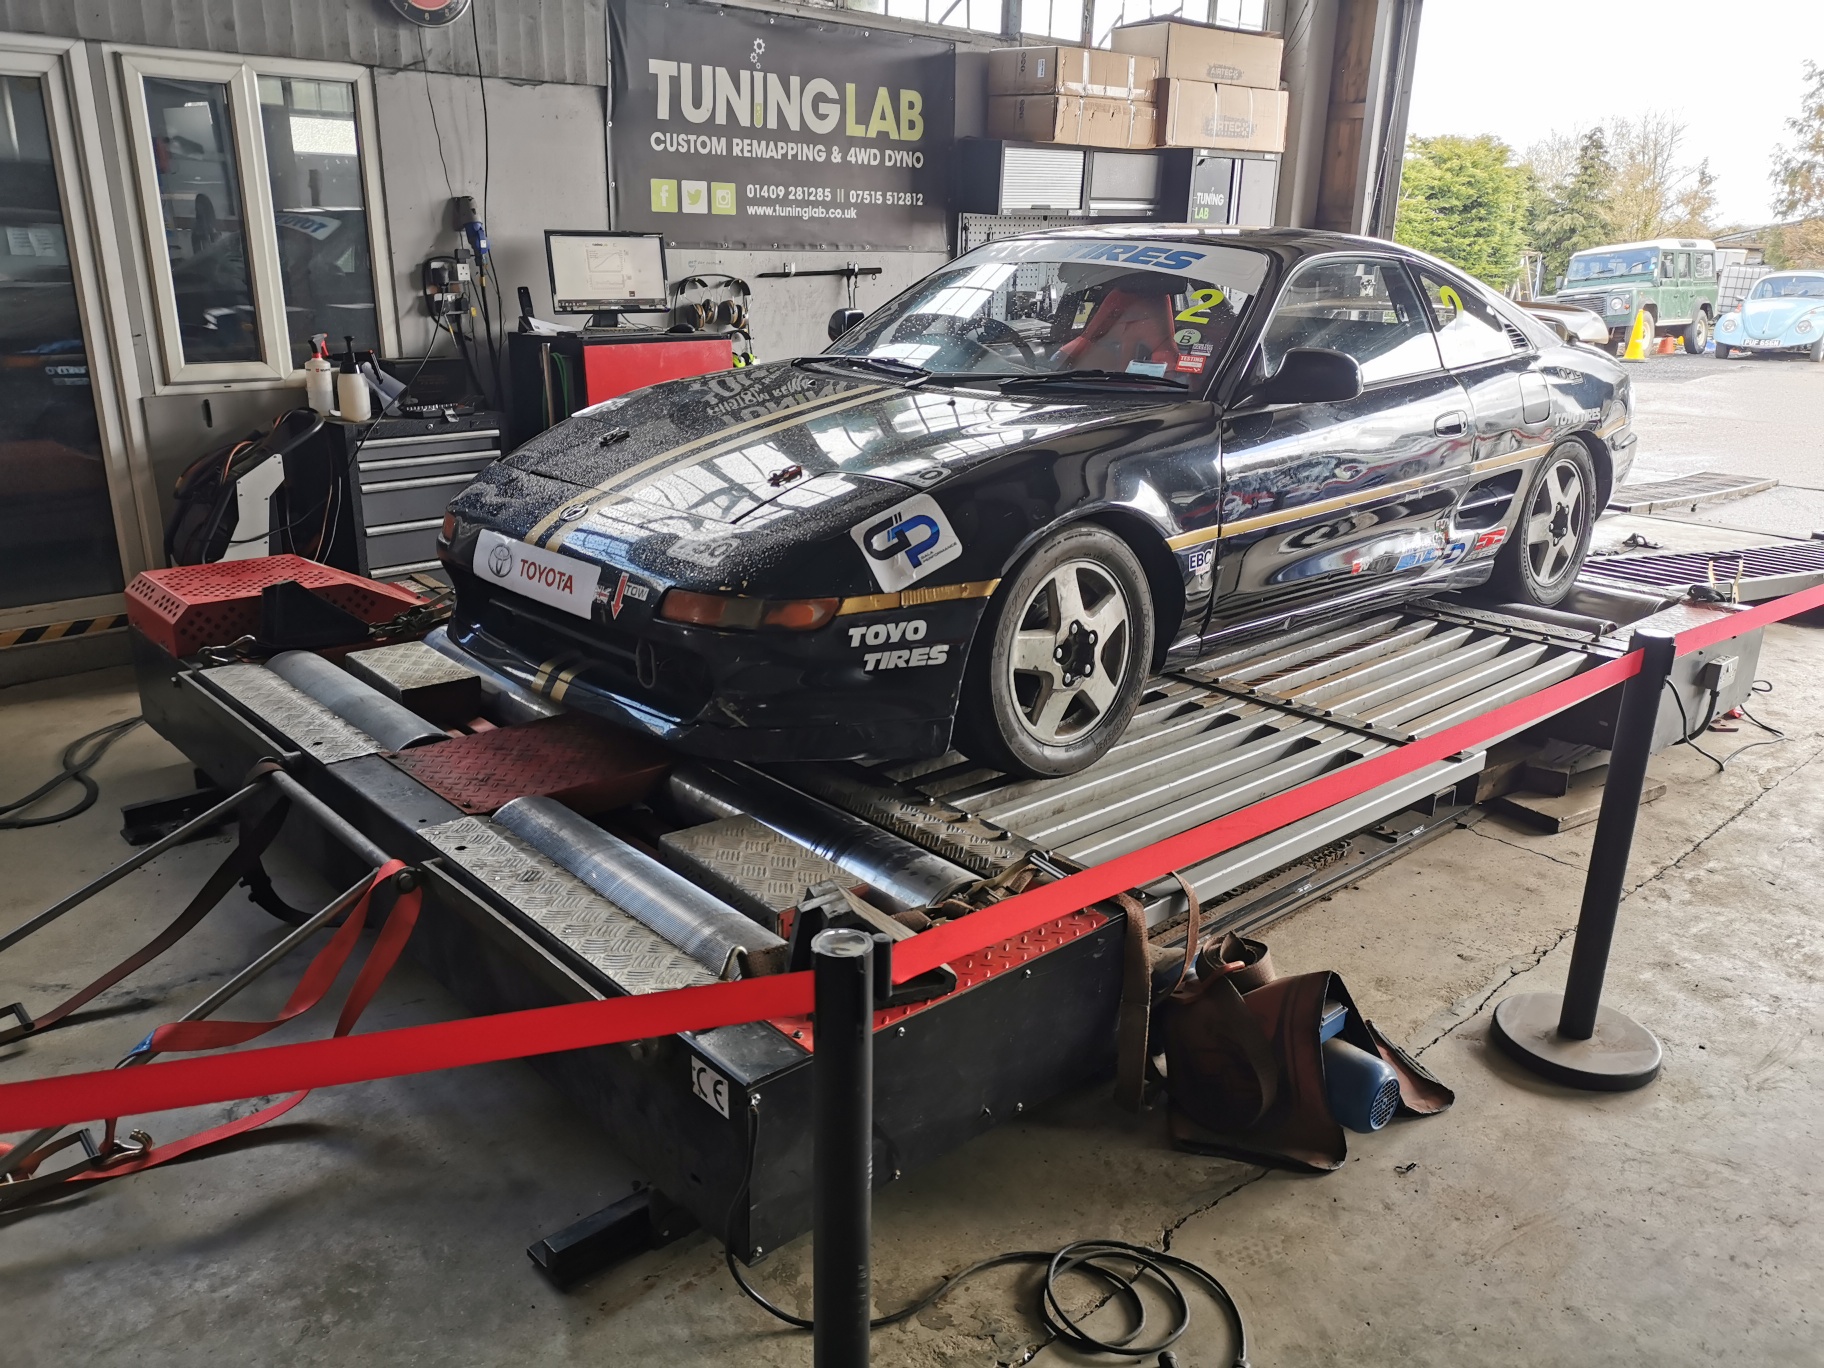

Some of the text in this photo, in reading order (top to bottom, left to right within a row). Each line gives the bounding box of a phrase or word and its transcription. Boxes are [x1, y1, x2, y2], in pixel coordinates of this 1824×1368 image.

[650, 131, 924, 168] CUSTOM REMAPPING & 4WD DYNO
[746, 184, 784, 200] 01409
[788, 186, 832, 201] 281285
[849, 190, 883, 204] 07515
[886, 191, 924, 206] 512812
[1196, 191, 1225, 206] TUNING
[746, 204, 857, 220] www.tuninglab.co.uk
[1194, 206, 1209, 219] LAB
[1175, 288, 1224, 324] 2
[1179, 334, 1192, 344] B
[1190, 550, 1212, 569] EBC
[520, 558, 573, 595] TOYOTA
[625, 583, 648, 600] TOW
[848, 619, 928, 648] TOYO
[863, 644, 950, 672] TIRES
